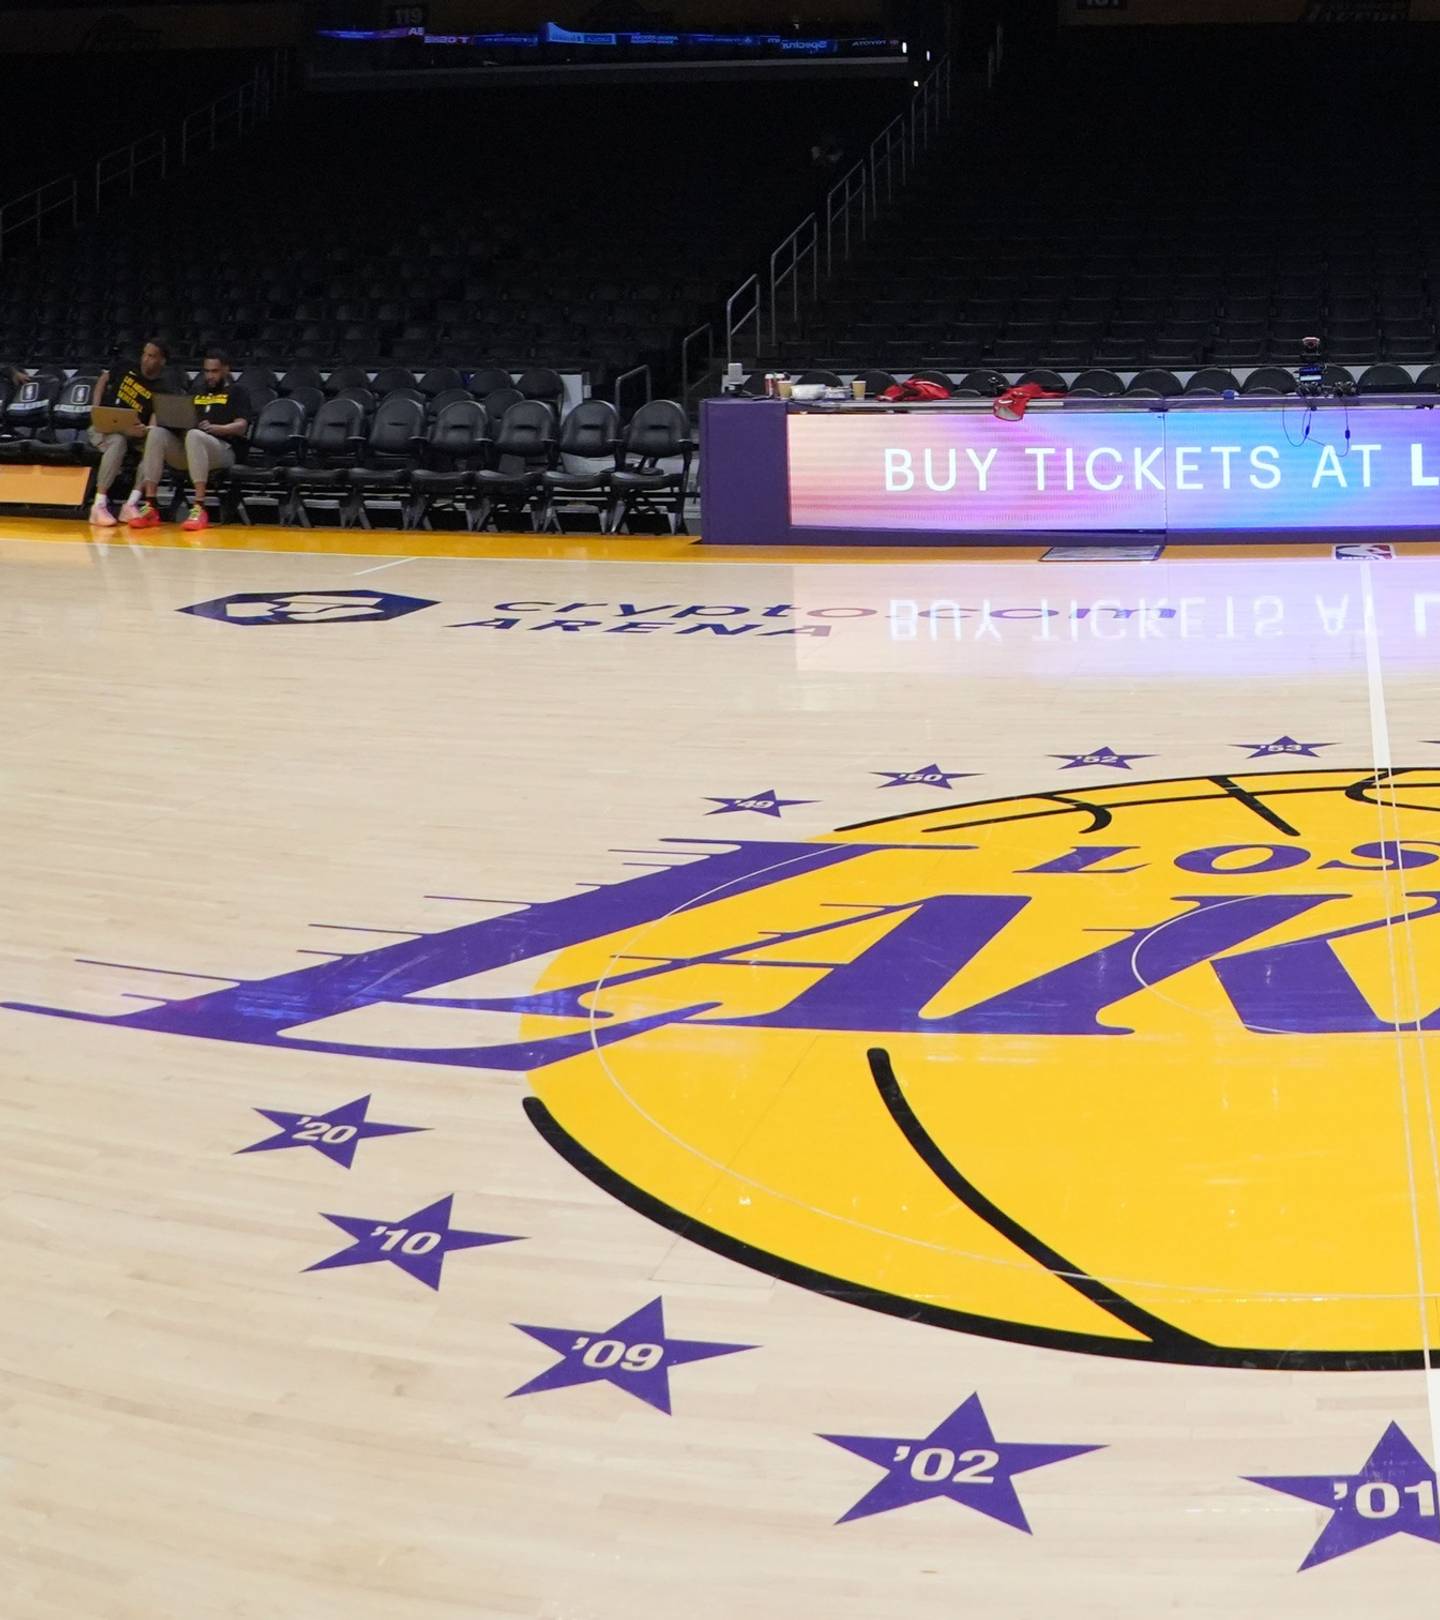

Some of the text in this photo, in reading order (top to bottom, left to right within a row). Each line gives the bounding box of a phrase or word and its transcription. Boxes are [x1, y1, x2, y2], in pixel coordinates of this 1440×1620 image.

[884, 446, 998, 492] BUY
[1025, 445, 1281, 492] TICKETS
[1312, 443, 1381, 489] AT
[445, 617, 832, 637] ARENA
[898, 772, 943, 783] '50
[734, 799, 775, 809] '49
[295, 1116, 358, 1144] '20
[371, 1225, 442, 1255] '10
[572, 1337, 665, 1371] '09
[894, 1446, 999, 1484] '02
[1333, 1480, 1436, 1519] '01
